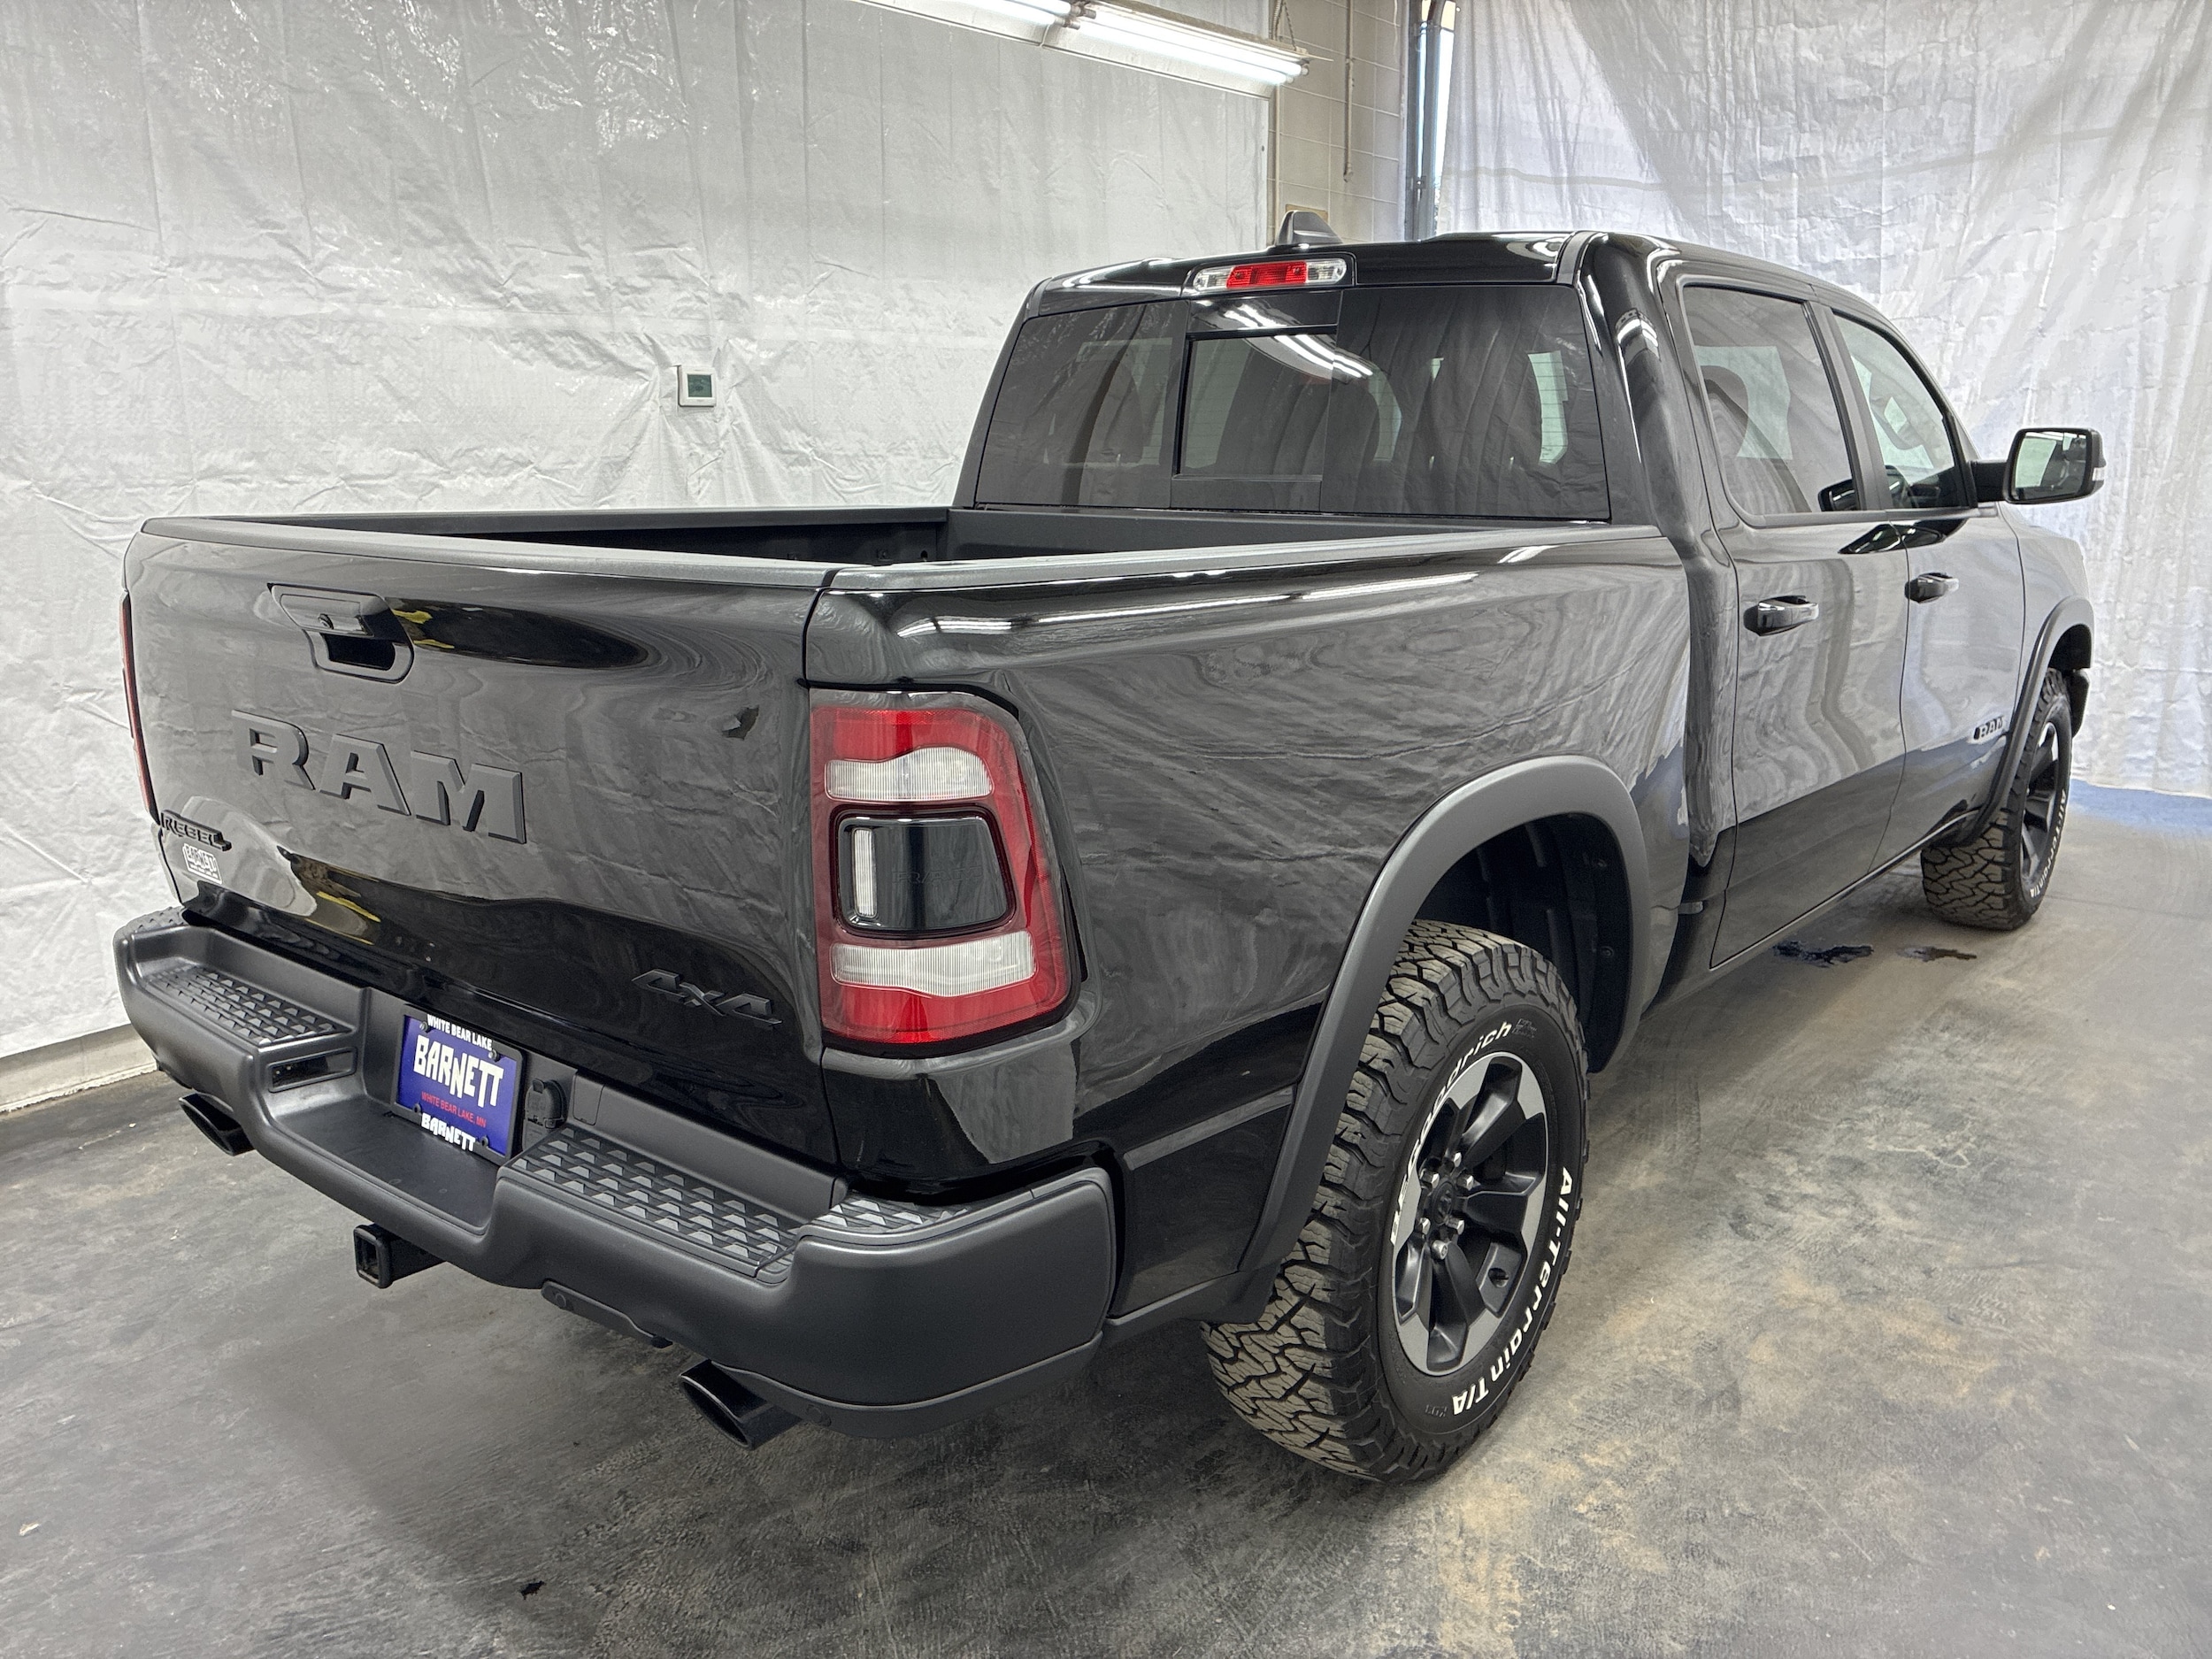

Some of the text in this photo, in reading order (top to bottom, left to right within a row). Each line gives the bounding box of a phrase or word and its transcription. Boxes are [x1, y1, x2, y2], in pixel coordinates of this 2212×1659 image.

[231, 709, 527, 844] RAM
[160, 809, 232, 851] REBEL
[427, 1014, 493, 1050] WHITE BEAR LAKE
[413, 1034, 504, 1108] BARNETT
[421, 1092, 440, 1107] WHITE
[441, 1100, 457, 1115] BEAR
[476, 1116, 487, 1128] MN
[421, 1112, 476, 1151] BARNETT
[1451, 1166, 1573, 1416] All-Terrain T/A
